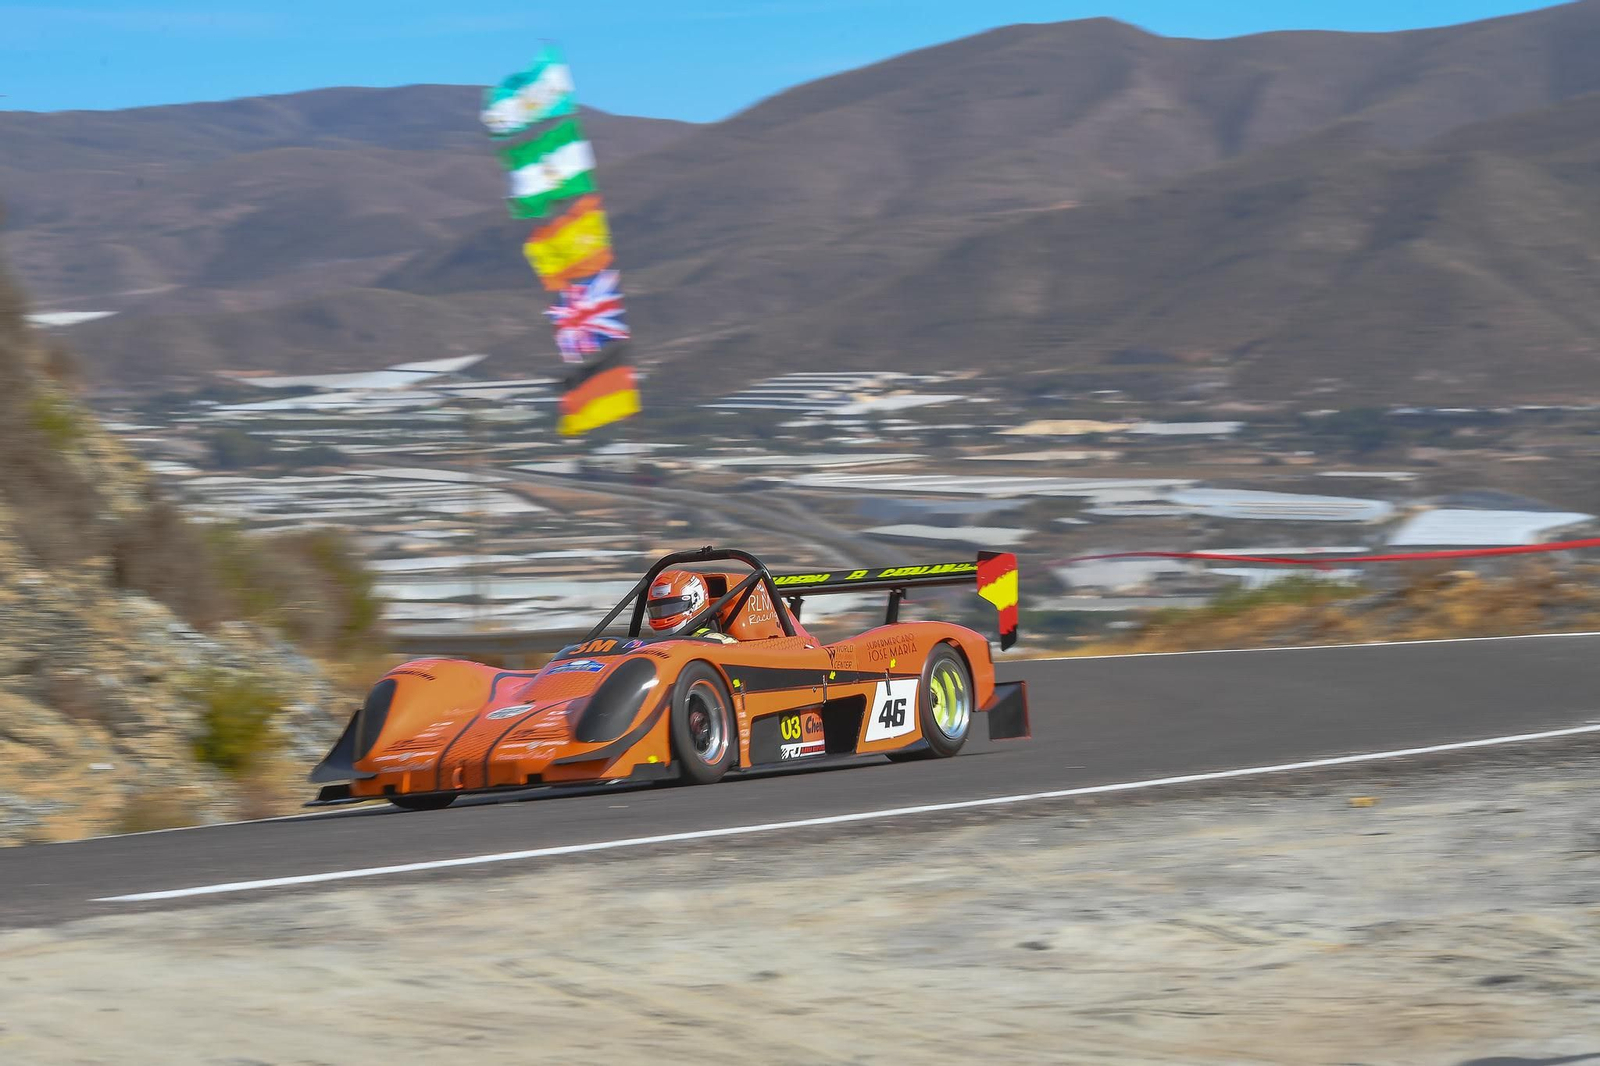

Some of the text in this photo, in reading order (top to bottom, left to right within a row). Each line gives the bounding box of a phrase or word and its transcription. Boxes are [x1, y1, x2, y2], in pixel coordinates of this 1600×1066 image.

[747, 593, 773, 612] RLM
[834, 660, 853, 669] CENTER
[878, 698, 907, 729] 46
[780, 715, 802, 741] 03
